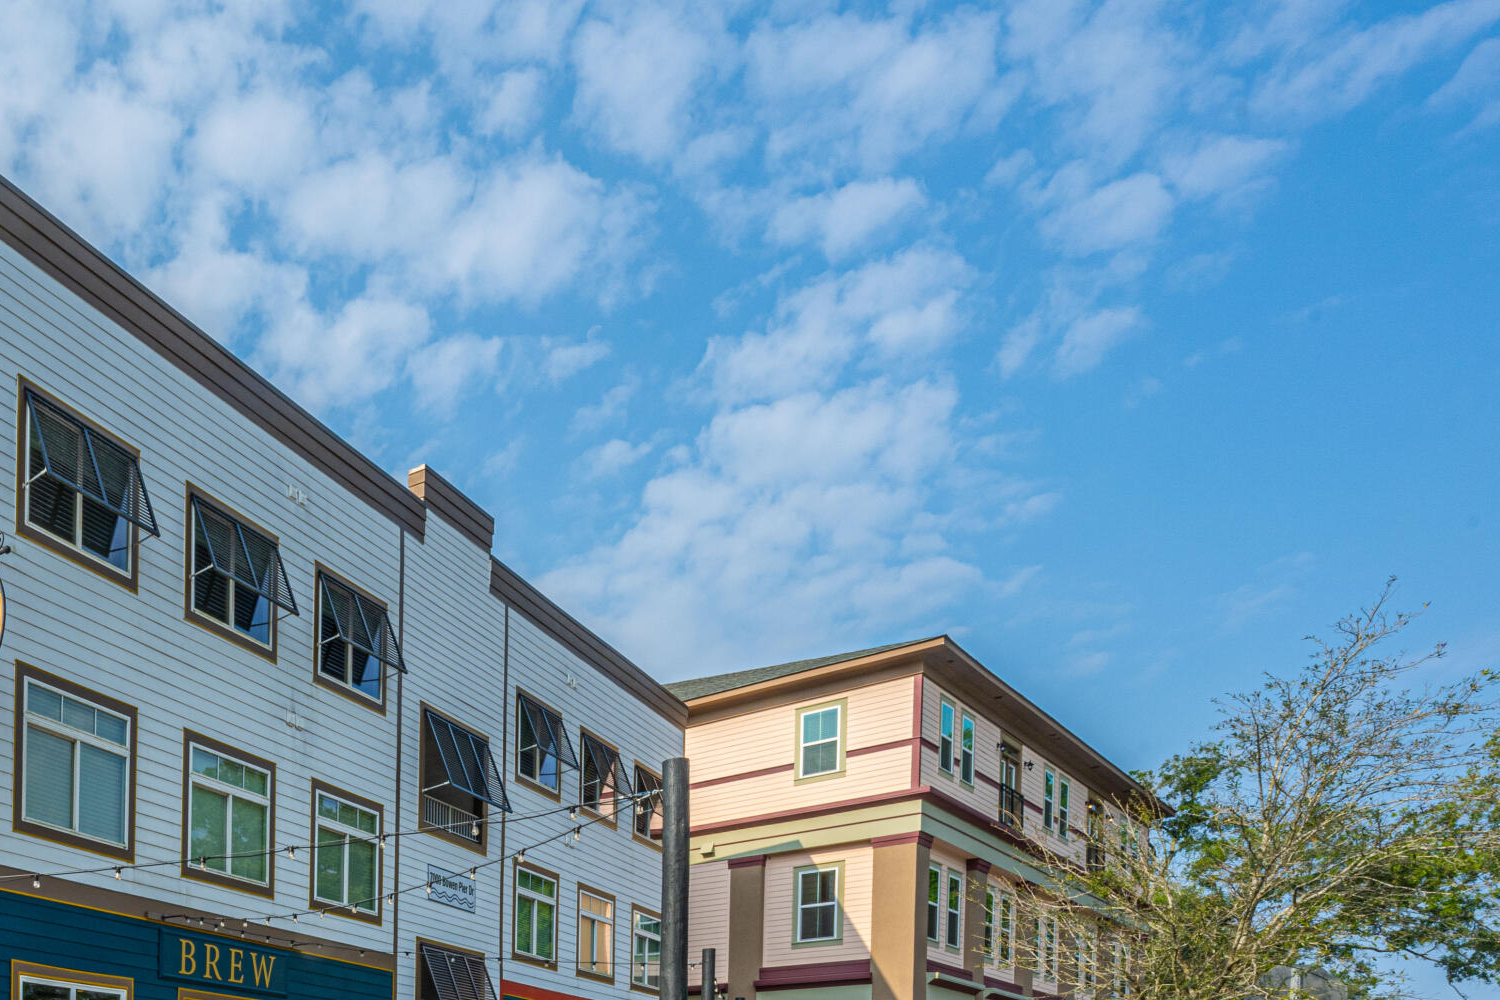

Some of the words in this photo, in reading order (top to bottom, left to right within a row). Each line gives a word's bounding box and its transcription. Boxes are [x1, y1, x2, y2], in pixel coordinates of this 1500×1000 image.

[442, 875, 458, 891] Bowen
[459, 881, 468, 893] Pier
[469, 884, 474, 896] Dr
[178, 938, 276, 988] BREW
